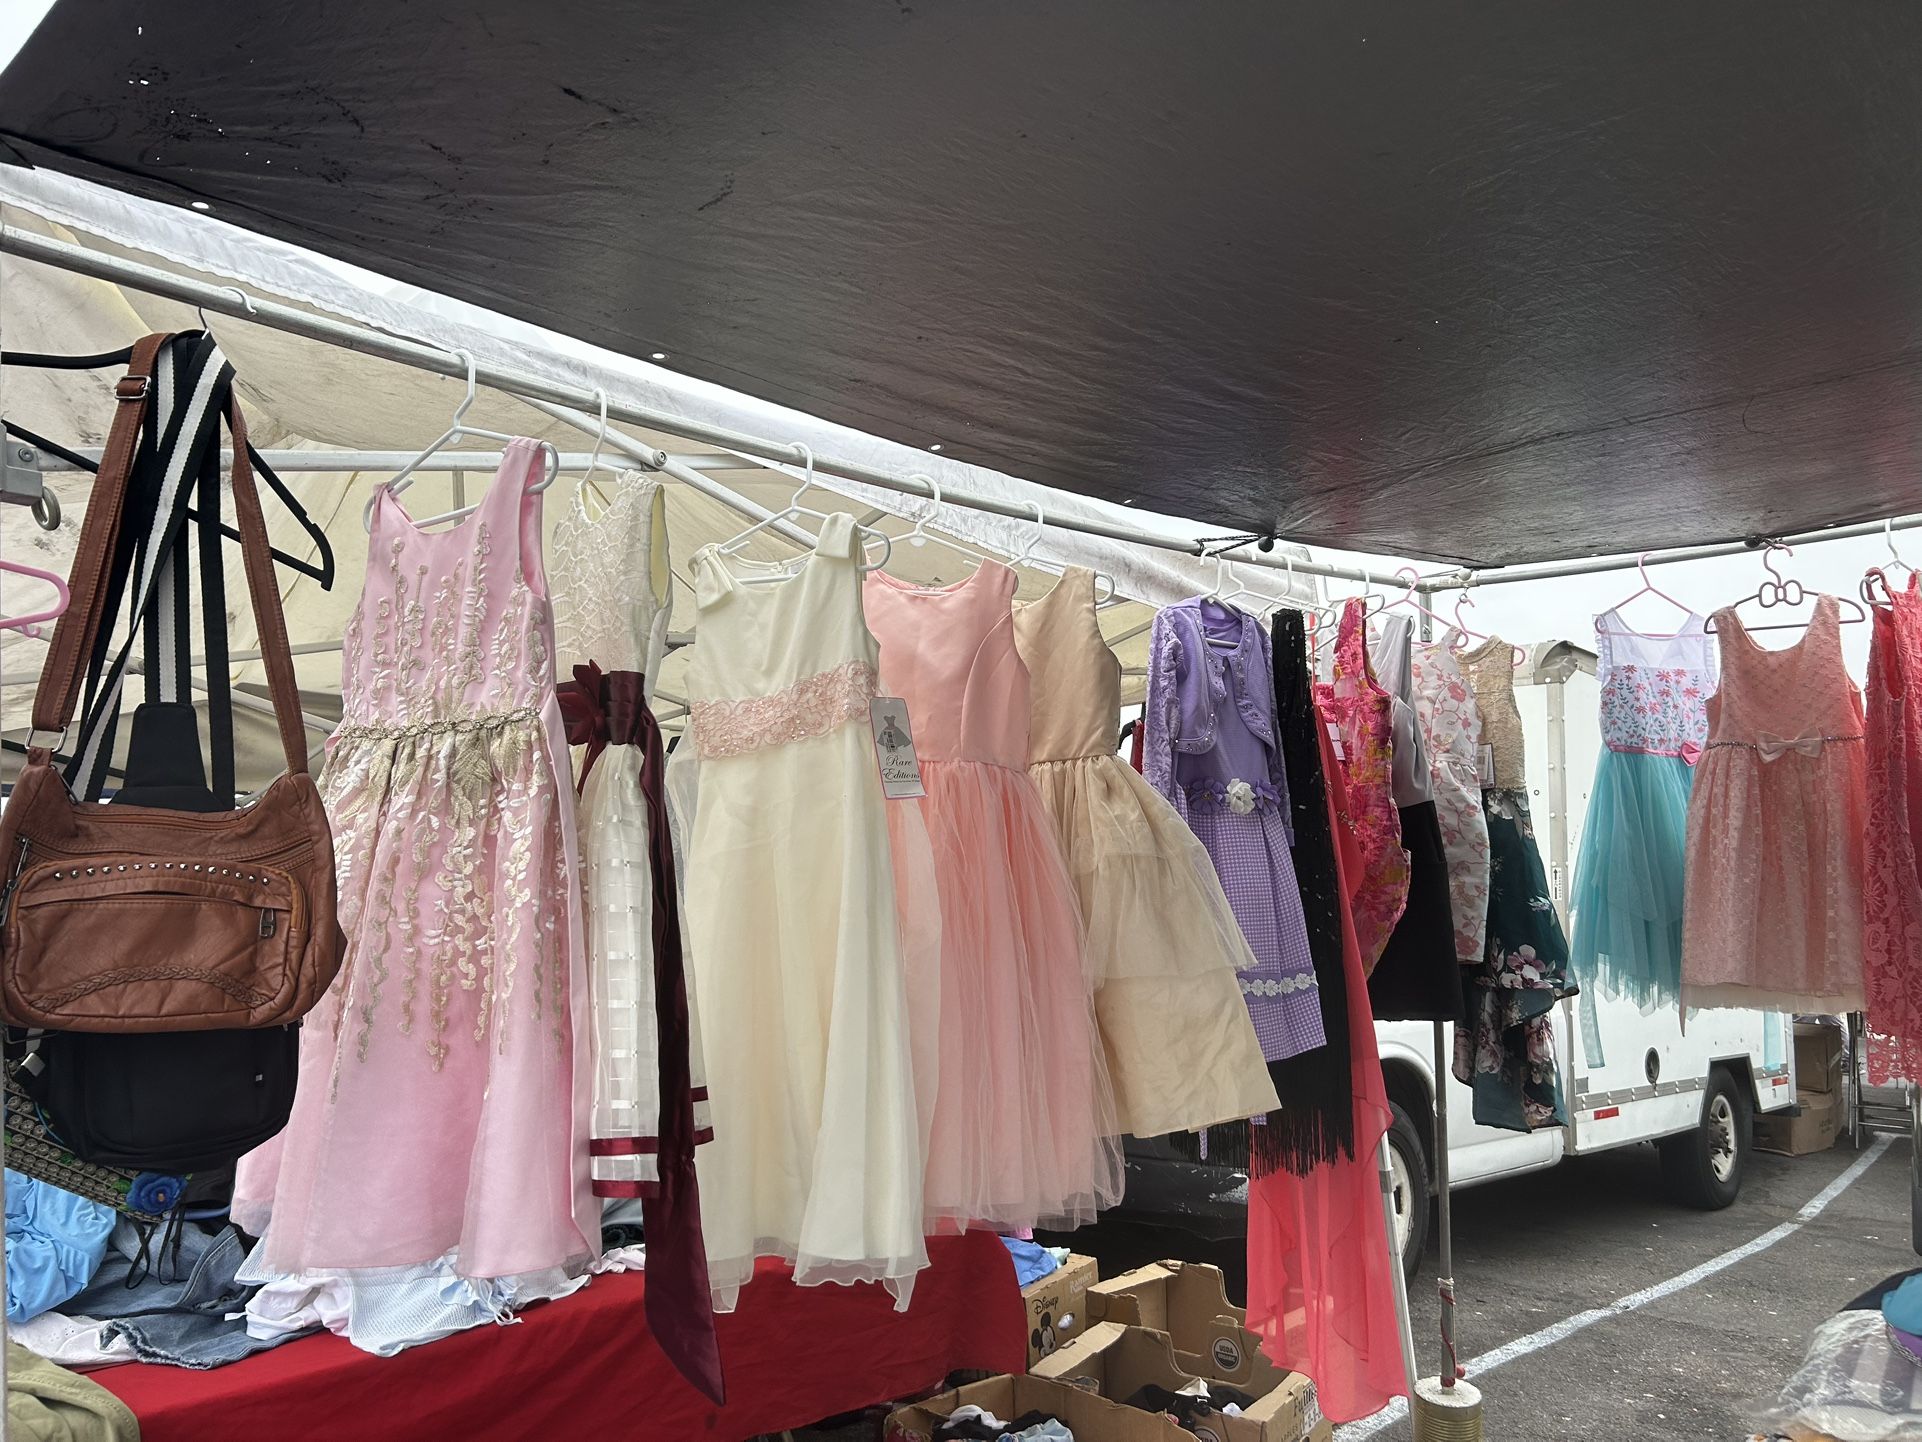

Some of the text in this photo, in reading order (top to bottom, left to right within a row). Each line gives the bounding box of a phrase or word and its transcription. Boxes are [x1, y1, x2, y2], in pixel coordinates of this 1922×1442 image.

[886, 754, 912, 766] Rare
[882, 768, 920, 780] Editions
[1032, 1296, 1059, 1315] Disney
[1219, 1344, 1234, 1354] USDA
